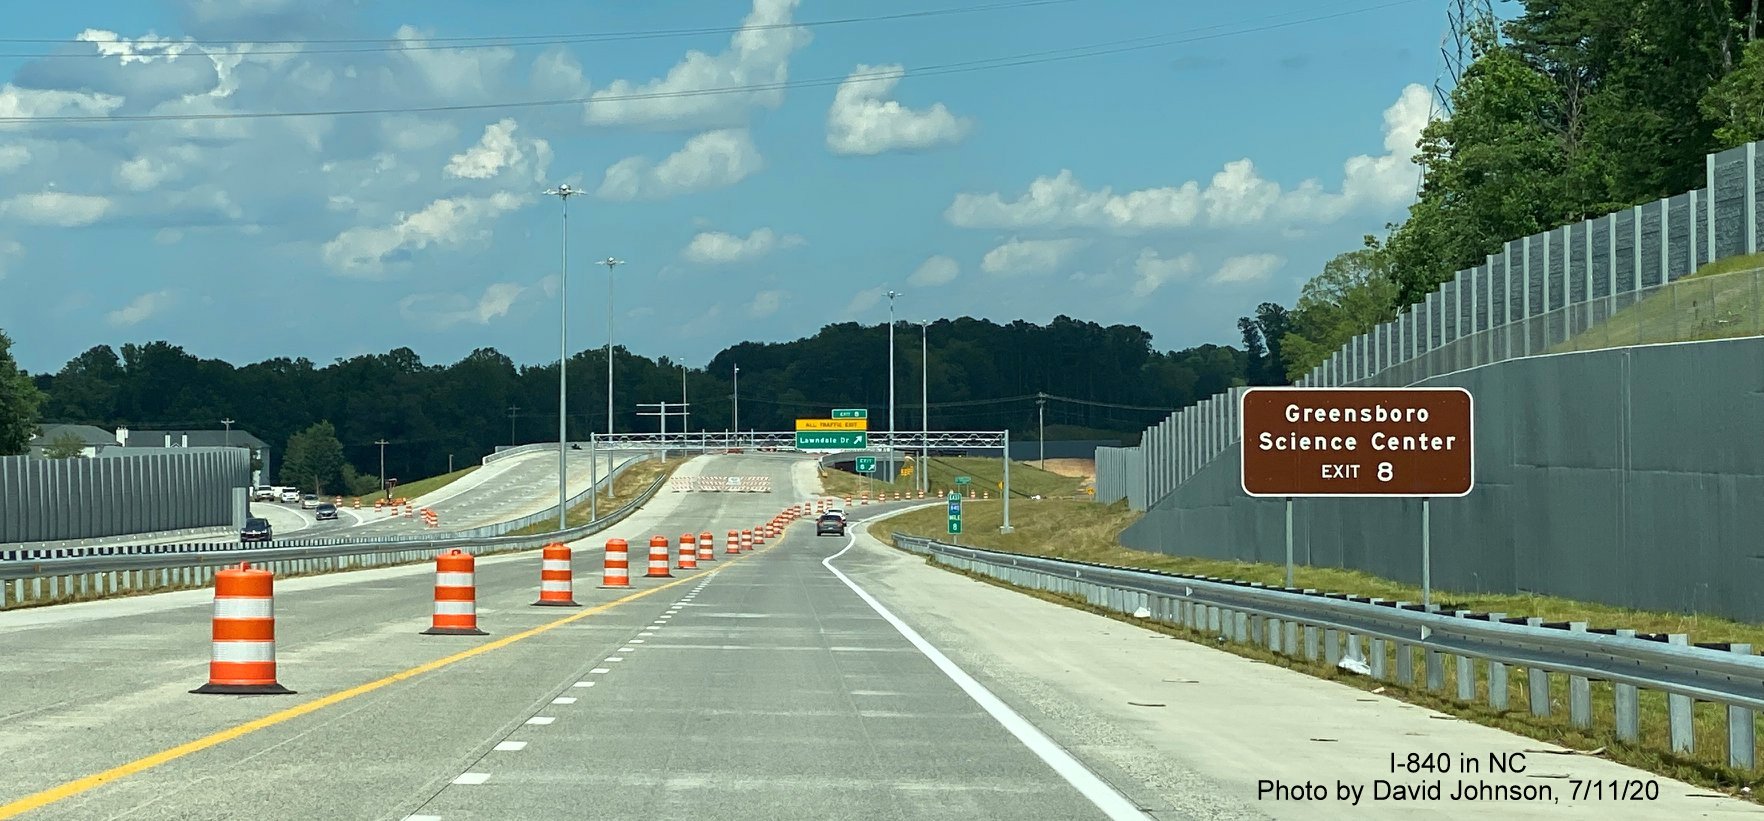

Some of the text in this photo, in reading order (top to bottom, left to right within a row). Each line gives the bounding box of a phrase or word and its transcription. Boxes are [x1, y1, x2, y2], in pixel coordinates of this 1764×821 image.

[1285, 404, 1429, 423] Greensboro
[1258, 432, 1456, 451] Science Center
[1321, 461, 1394, 482] EXIT 8
